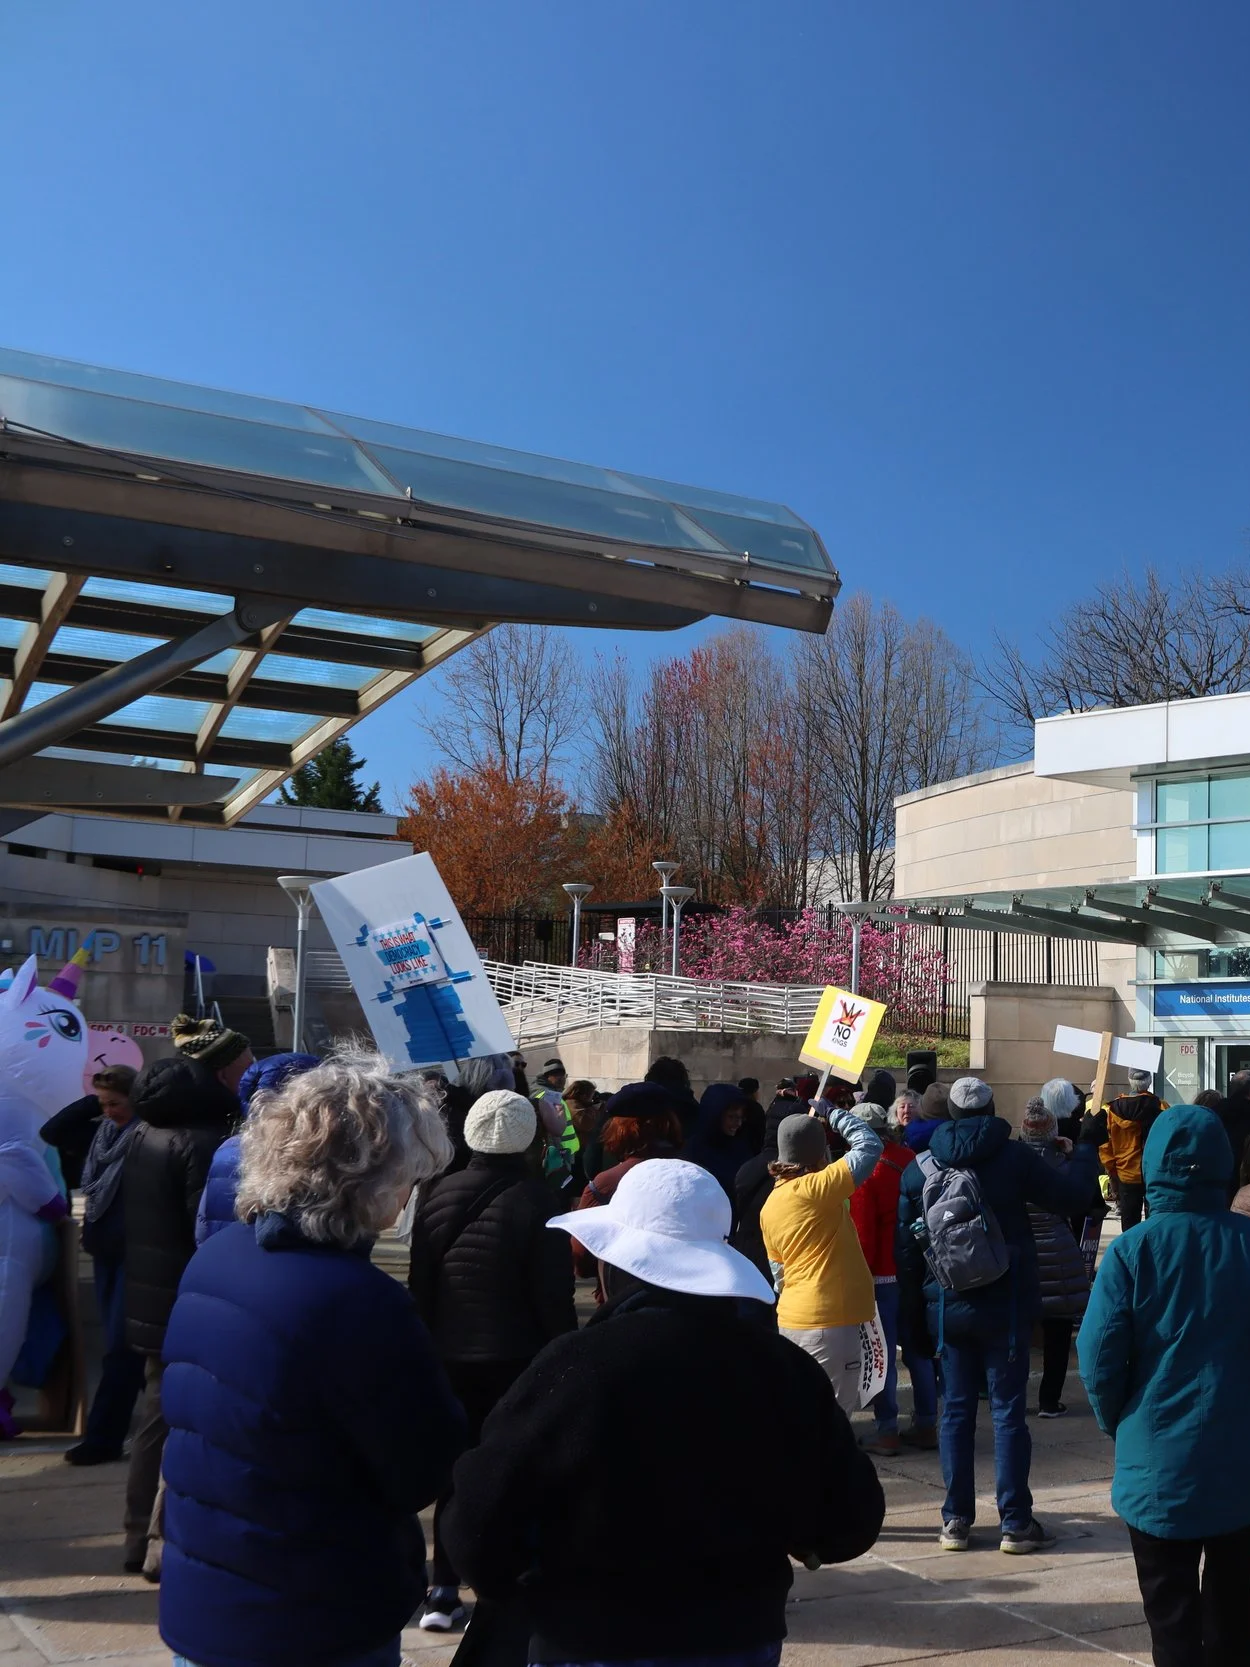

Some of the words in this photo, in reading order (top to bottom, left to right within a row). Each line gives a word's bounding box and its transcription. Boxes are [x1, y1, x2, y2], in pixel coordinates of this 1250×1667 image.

[400, 932, 416, 945] WHAT
[133, 932, 168, 967] 11
[384, 943, 421, 963] DEMOCRACY
[390, 959, 412, 975] LOOKS
[411, 957, 428, 970] LIKE
[1180, 994, 1213, 1004] National
[133, 1025, 157, 1036] FDC
[834, 1024, 851, 1041] NO
[831, 1037, 848, 1048] KINGS
[1180, 1045, 1195, 1055] FDC
